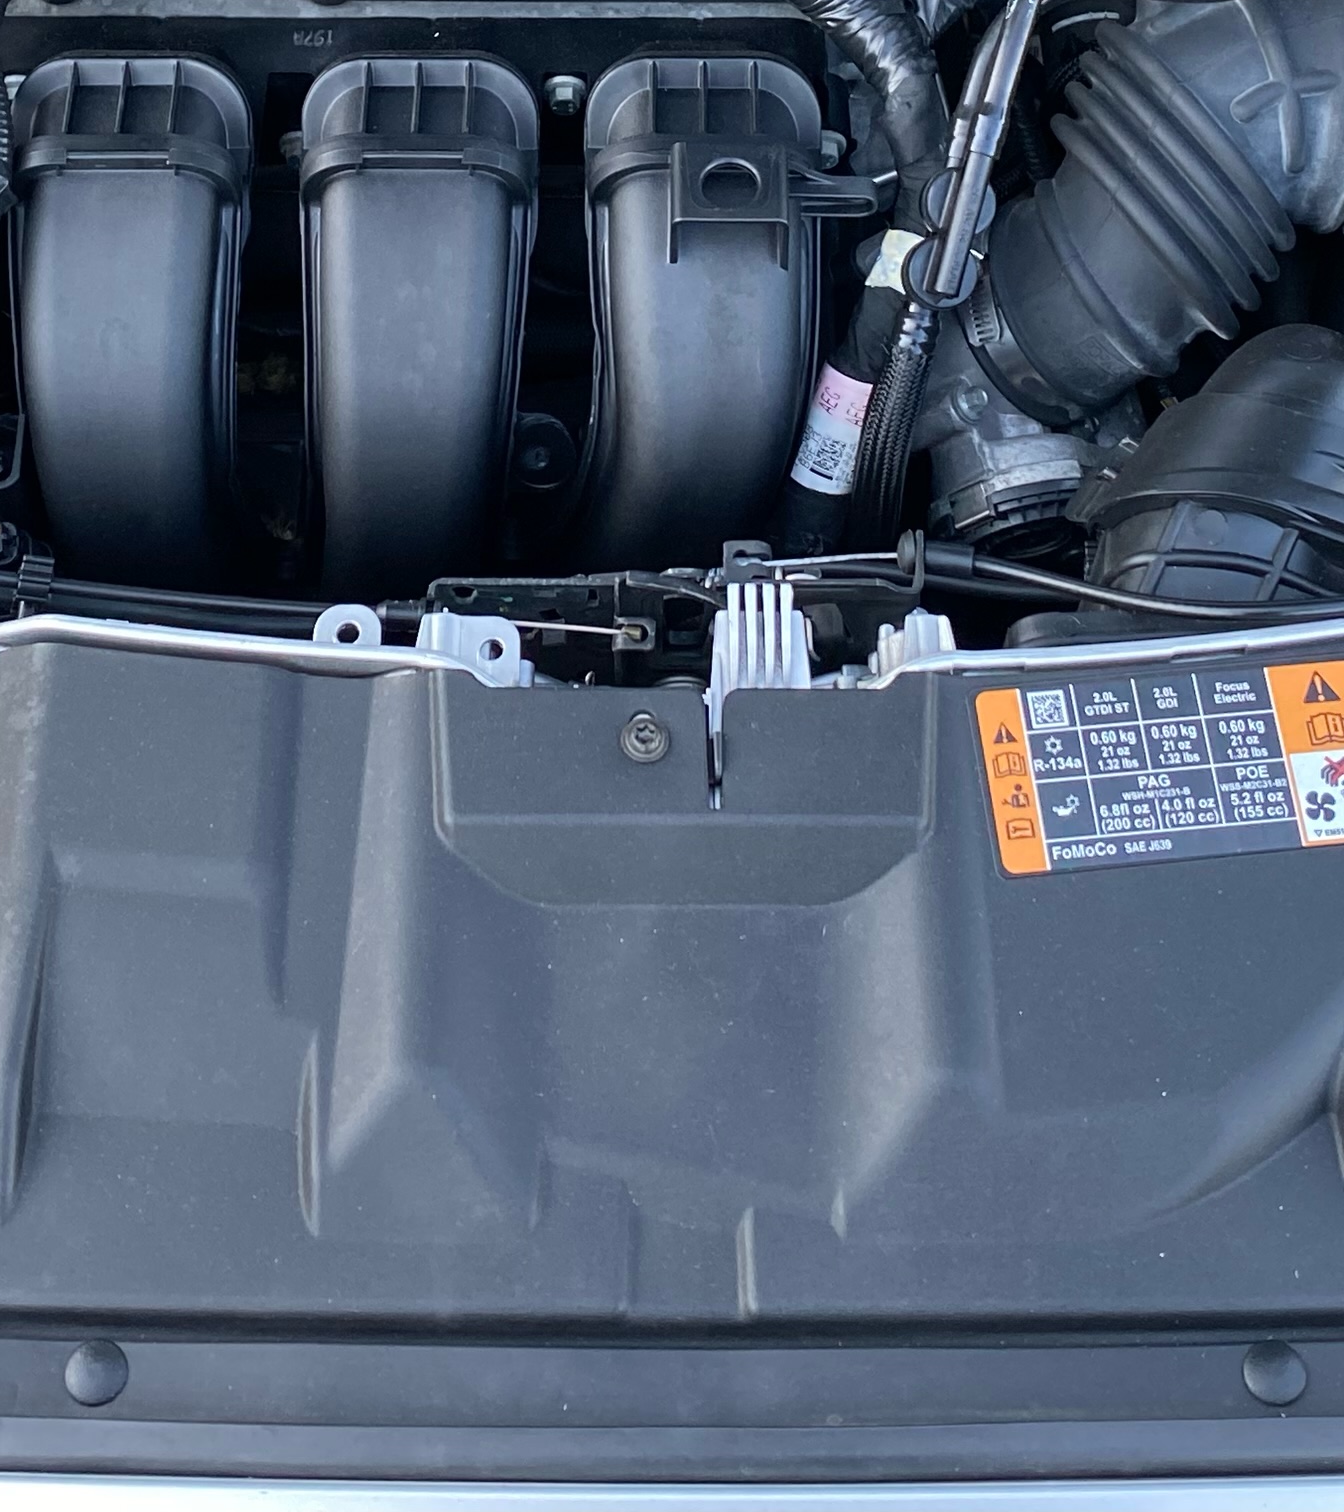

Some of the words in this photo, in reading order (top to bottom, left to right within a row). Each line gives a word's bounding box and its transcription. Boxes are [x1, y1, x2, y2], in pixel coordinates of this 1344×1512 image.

[818, 386, 840, 415] AEG
[1214, 682, 1250, 692] Focus
[1093, 691, 1118, 704] 2.0L
[1156, 698, 1178, 710] GDI
[1214, 692, 1257, 705] Electric
[1084, 704, 1113, 717] GTDI
[1115, 702, 1130, 714] ST
[1150, 724, 1178, 740] 0.60
[1179, 724, 1198, 739] kg
[1218, 720, 1246, 734] 0.60
[1247, 718, 1266, 734] kg
[1090, 730, 1117, 746] 0.60
[1119, 729, 1137, 745] kg
[1230, 736, 1243, 746] 21
[1246, 735, 1260, 744] oz
[1100, 747, 1114, 758] 21
[1116, 746, 1131, 756] oz
[1162, 741, 1175, 752] 21
[1178, 740, 1192, 750] oz
[1226, 748, 1250, 760] 1.32
[1250, 746, 1268, 757] lbs
[1033, 756, 1082, 773] R-134a
[1098, 759, 1121, 772] 1.32
[1122, 758, 1139, 769] lbs
[1158, 752, 1182, 765] 1.32
[1183, 752, 1200, 762] lbs
[1236, 765, 1270, 780] POE
[1137, 774, 1171, 789] PAG
[1162, 798, 1182, 812] 4.0
[1185, 798, 1196, 810] fl
[1198, 798, 1216, 808] oz
[1230, 792, 1252, 806] 5.2
[1254, 791, 1264, 804] fl
[1267, 790, 1285, 802] oz
[1132, 803, 1150, 814] oz
[1234, 805, 1264, 822] (155
[1266, 803, 1289, 818] cc)
[1101, 818, 1130, 834] (200
[1134, 814, 1156, 830] cc)
[1165, 812, 1194, 828] (120
[1198, 808, 1220, 825] cc)
[1052, 842, 1118, 860] FoMoCo
[1124, 841, 1147, 854] SAE
